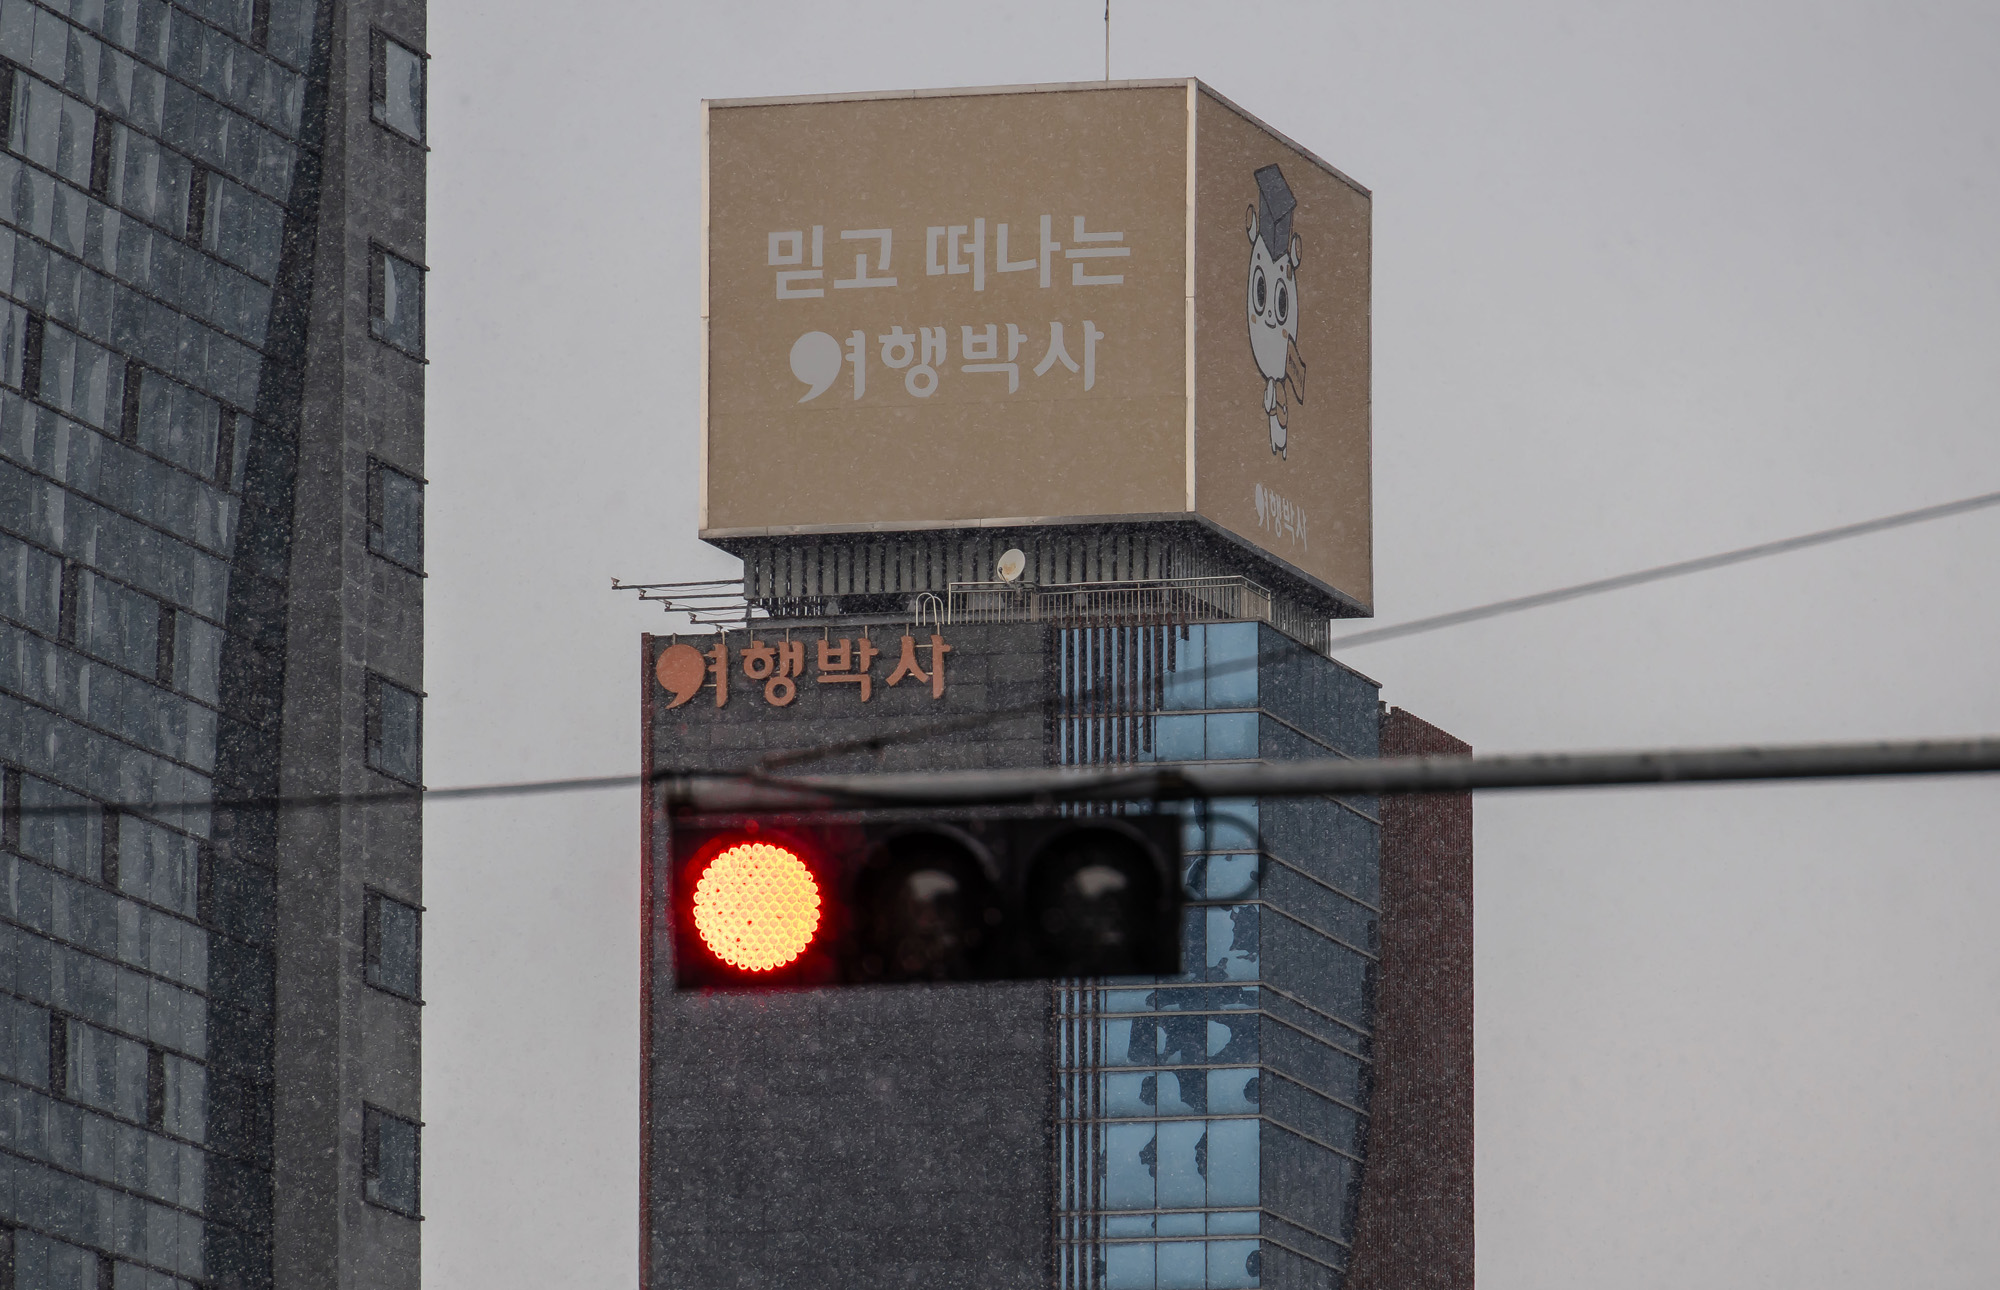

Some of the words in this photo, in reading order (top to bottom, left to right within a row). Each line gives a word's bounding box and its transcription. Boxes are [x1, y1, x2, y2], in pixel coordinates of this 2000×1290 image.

[768, 225, 897, 300] 믿고
[926, 214, 1131, 292] 떠나는
[789, 320, 1105, 404] 여행박사
[1255, 483, 1307, 552] 여행박사
[656, 634, 951, 710] 여행박사
